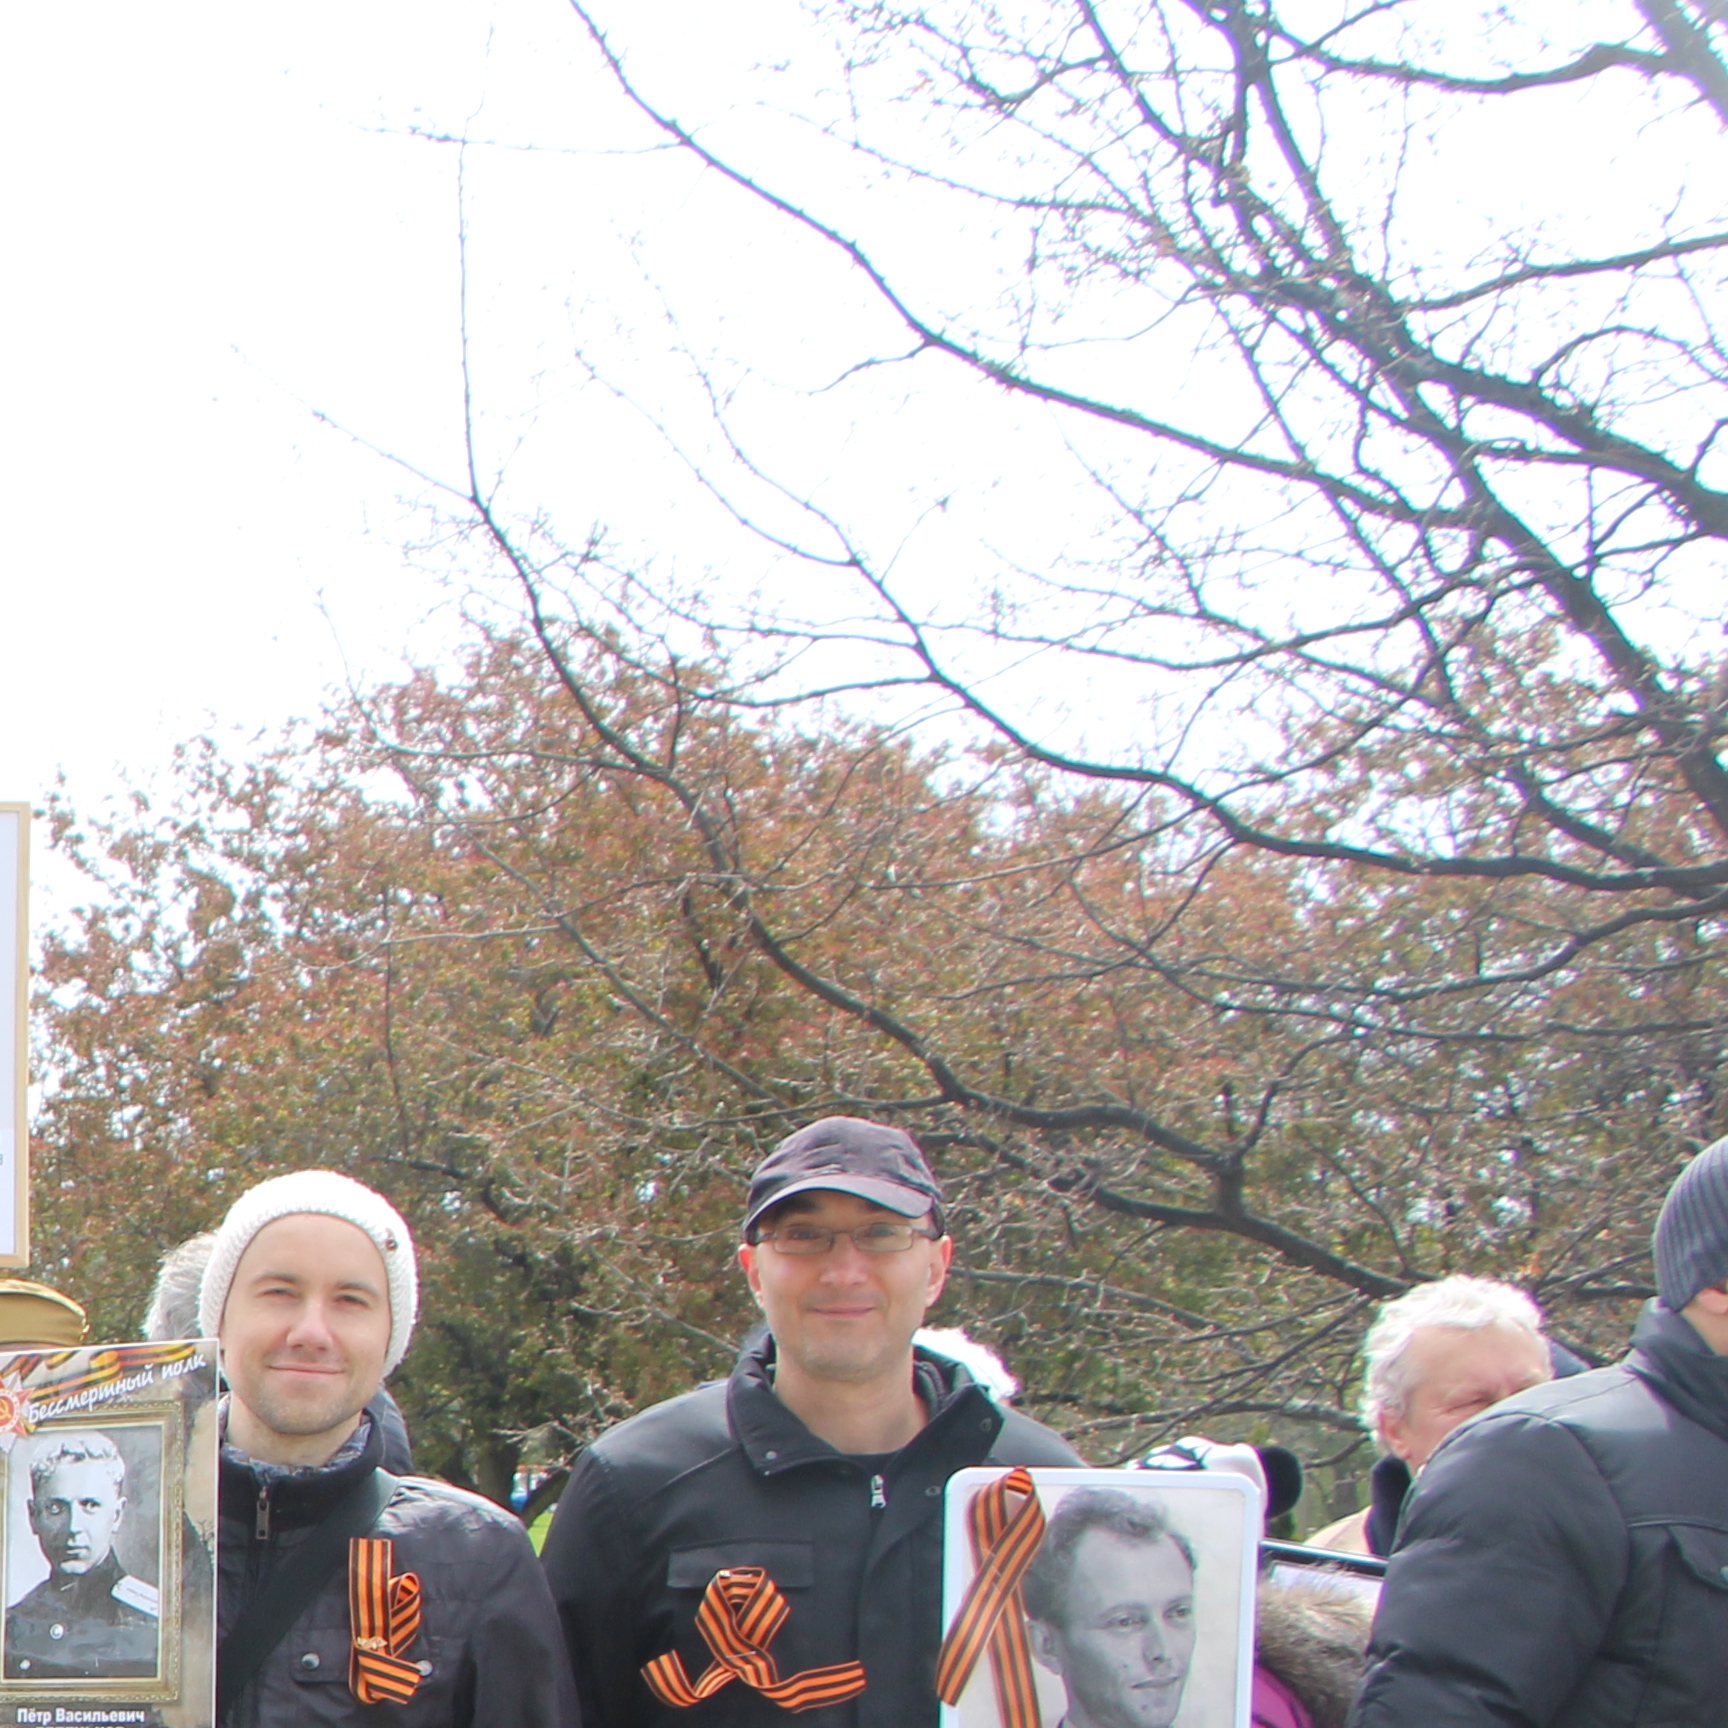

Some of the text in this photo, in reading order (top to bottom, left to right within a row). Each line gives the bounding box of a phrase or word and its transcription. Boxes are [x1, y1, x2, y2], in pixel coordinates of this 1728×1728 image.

[28, 1364, 153, 1424] Бессмертный
[162, 1353, 207, 1380] полк
[17, 1707, 145, 1725] Пётр Васильевич
